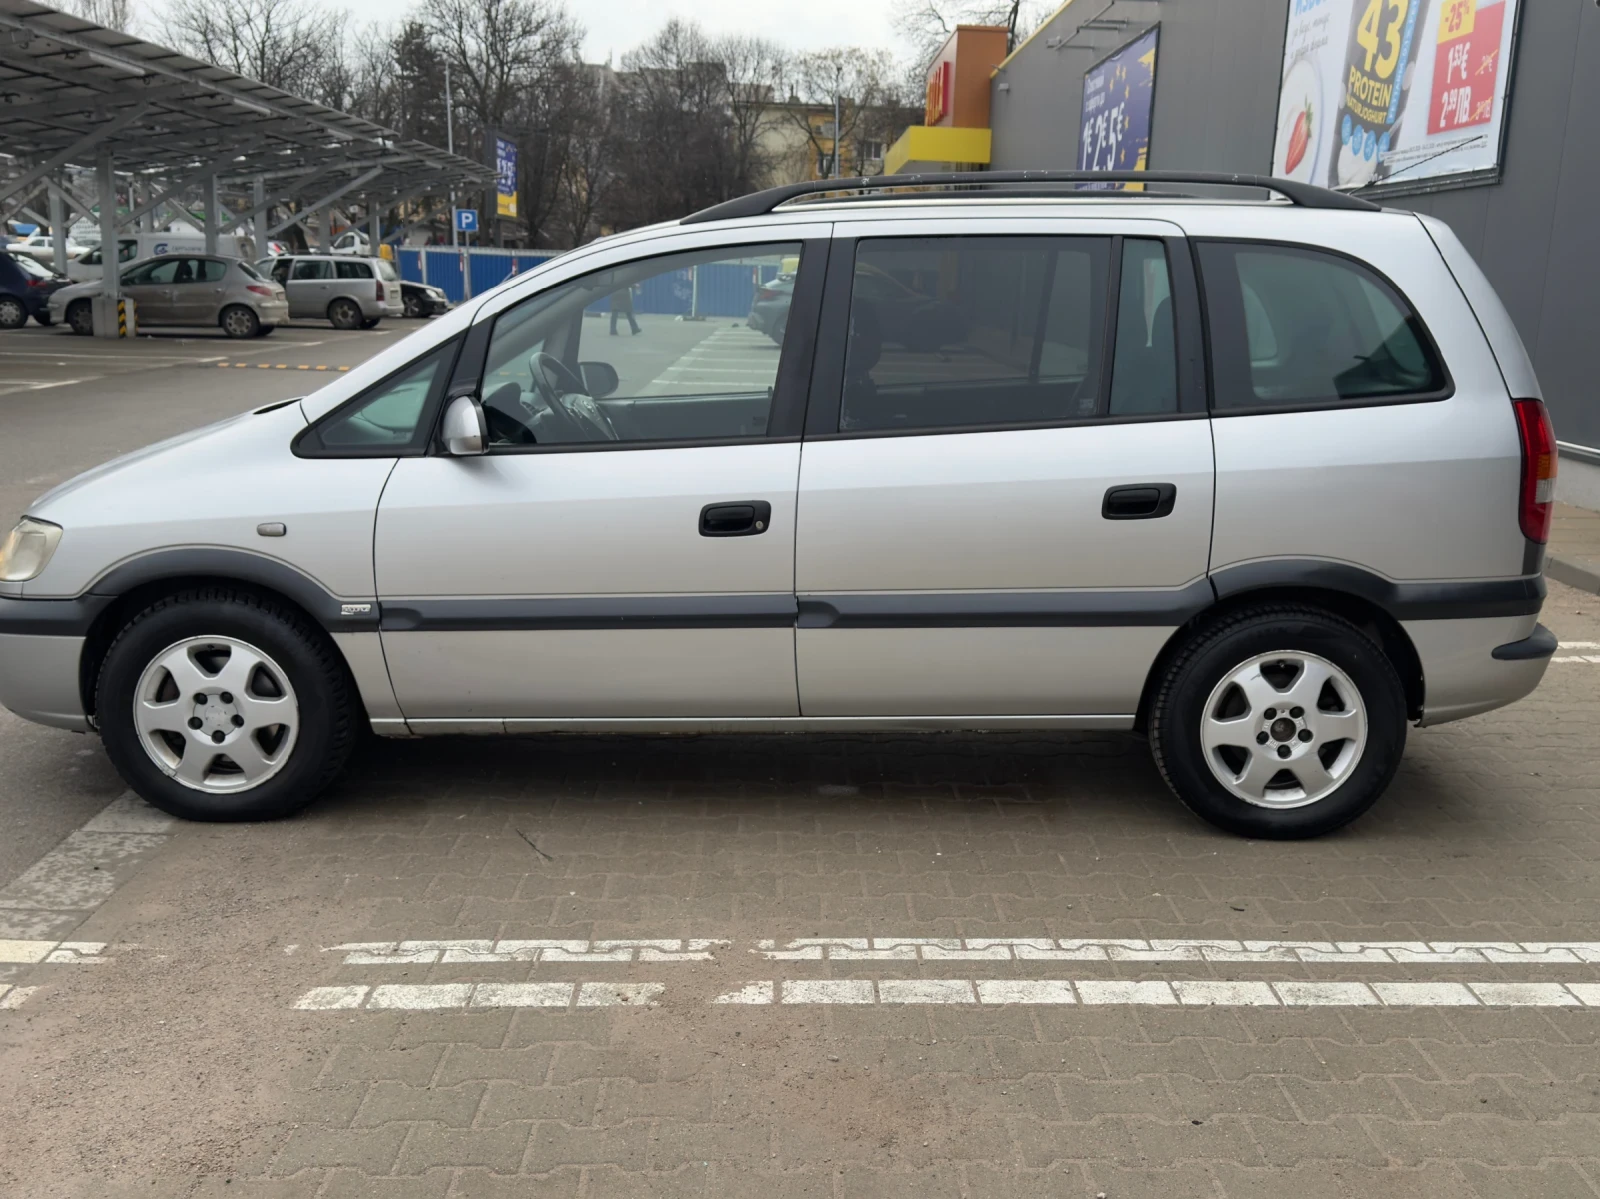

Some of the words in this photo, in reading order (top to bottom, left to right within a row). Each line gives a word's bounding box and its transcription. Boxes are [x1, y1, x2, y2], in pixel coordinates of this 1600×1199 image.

[1357, 0, 1409, 79] 43
[1348, 65, 1393, 109] PROTEIN
[461, 213, 473, 228] P
